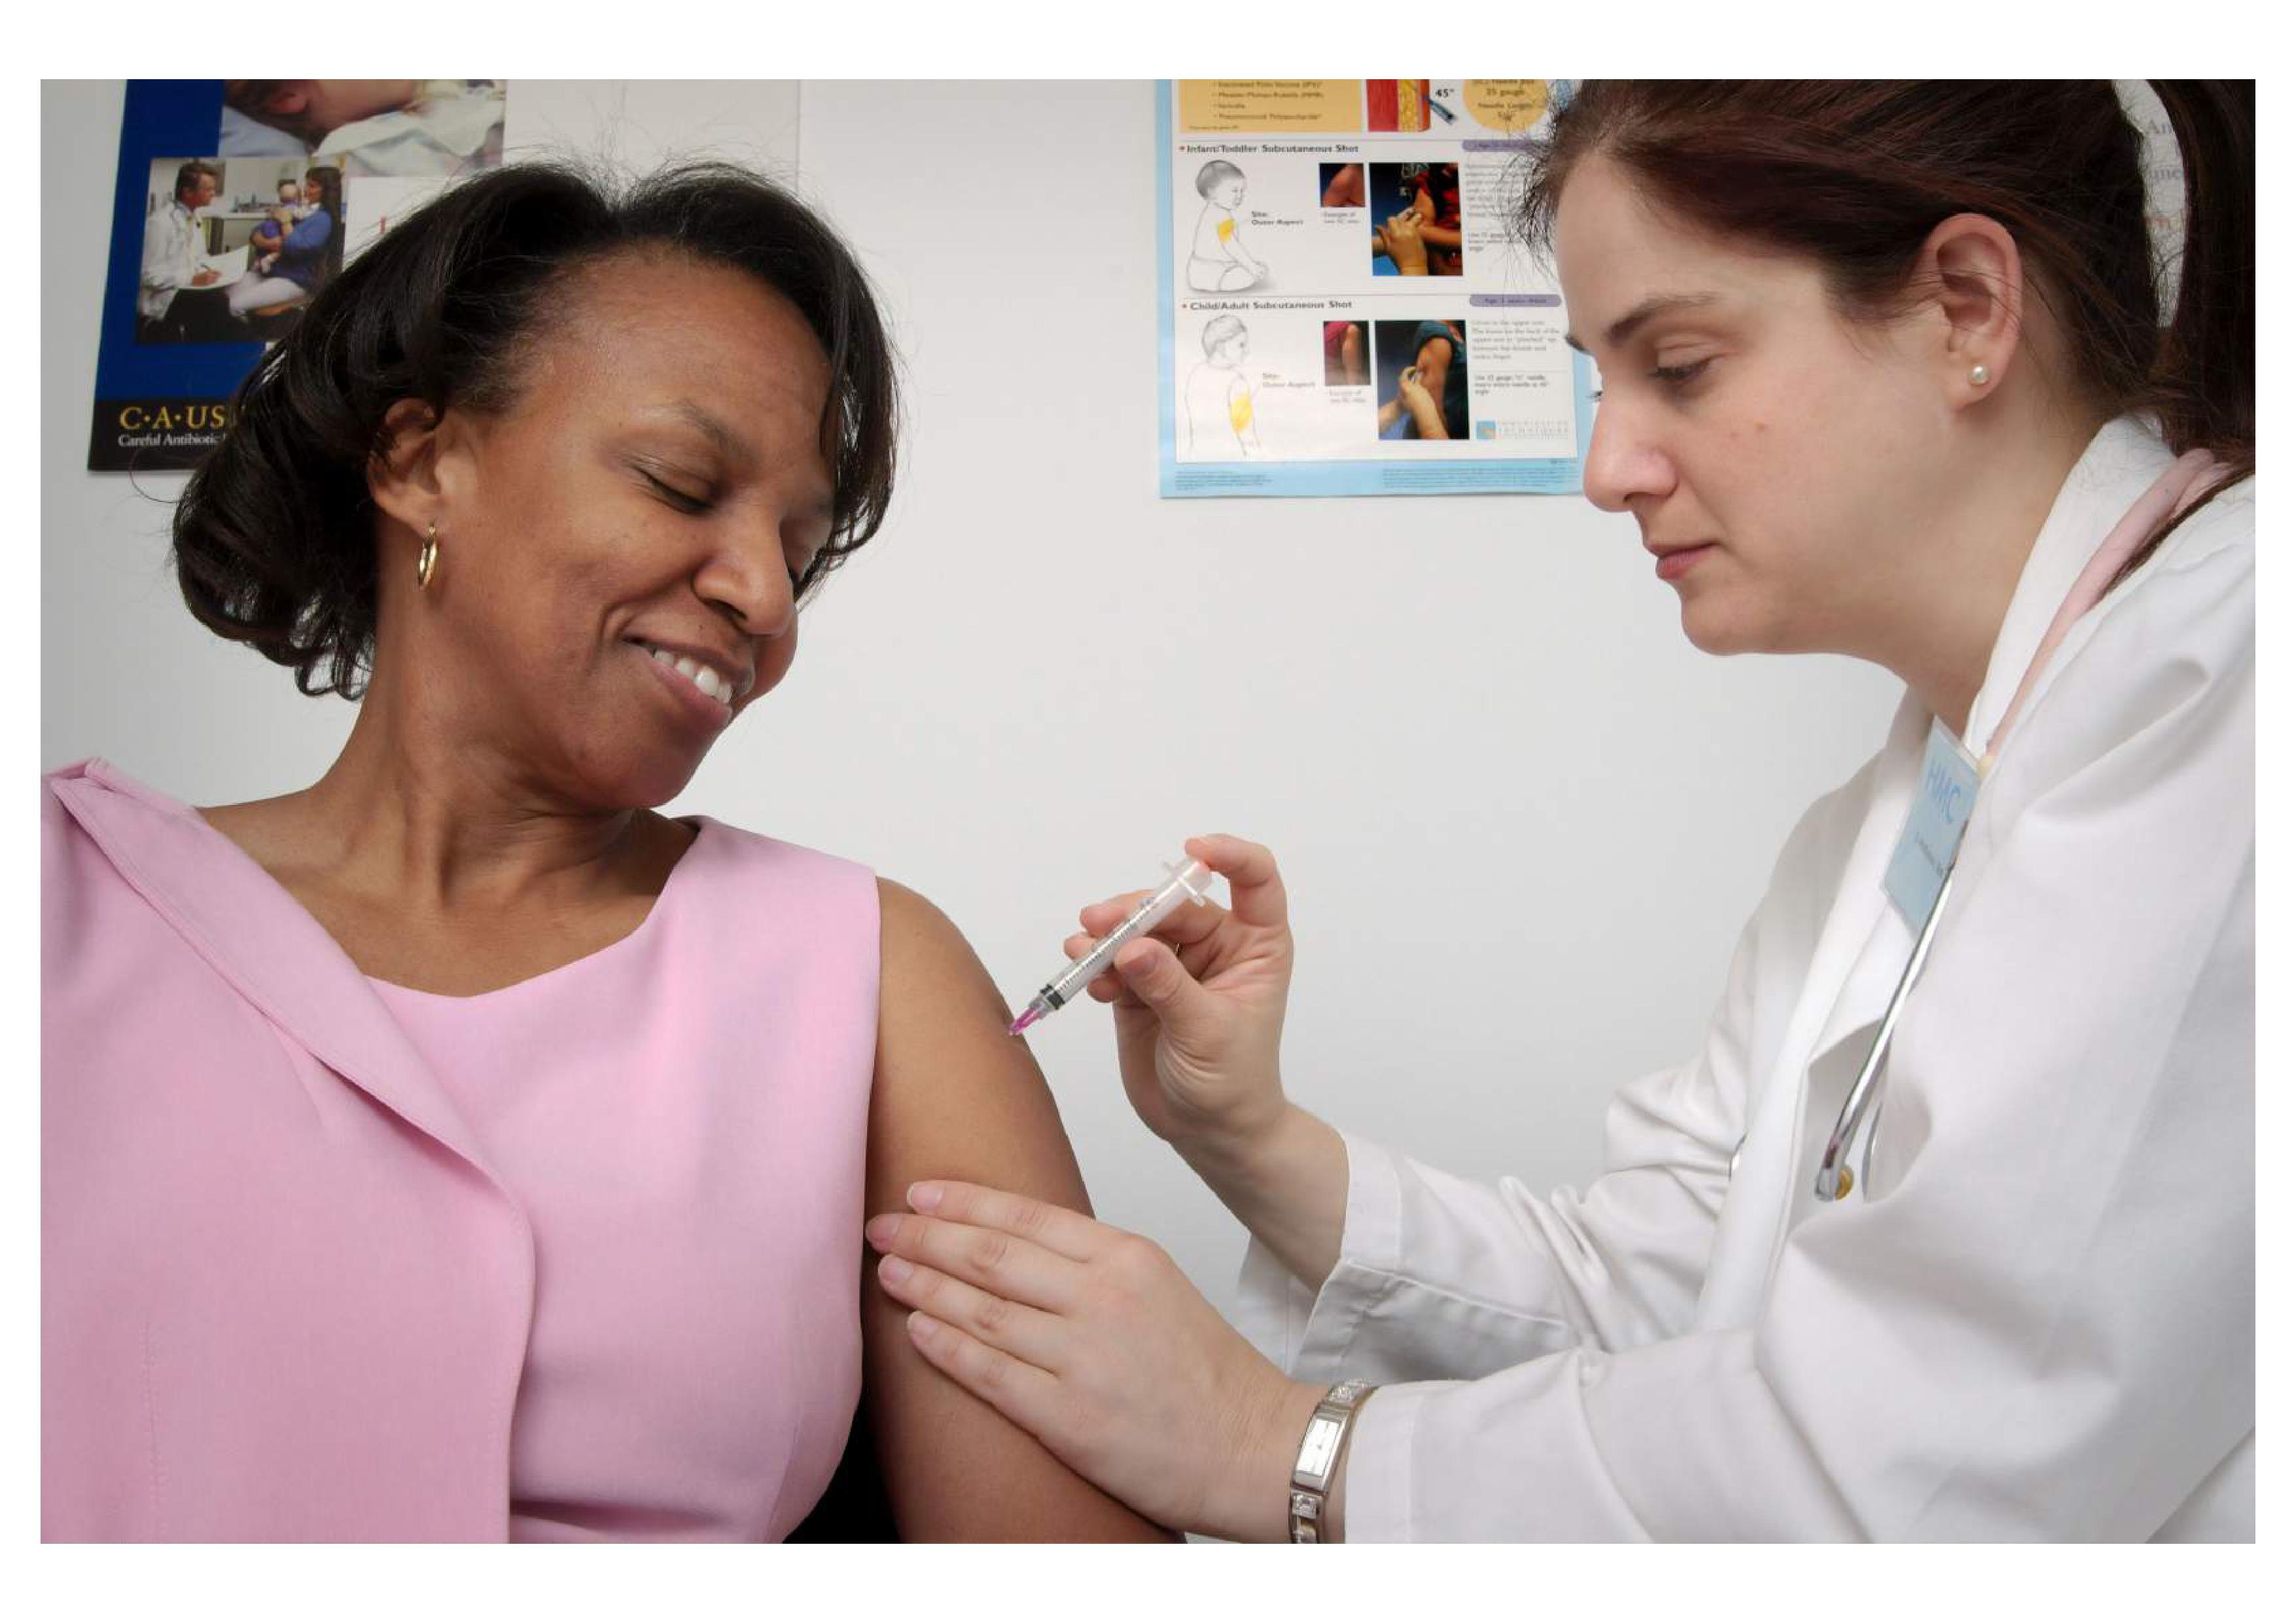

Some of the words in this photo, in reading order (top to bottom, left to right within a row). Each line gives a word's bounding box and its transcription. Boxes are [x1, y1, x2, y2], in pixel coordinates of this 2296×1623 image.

[1186, 144, 1258, 153] Infant/Toddler
[1262, 144, 1333, 153] Subcutaneous
[1335, 143, 1359, 153] Shot
[1190, 302, 1250, 311] Child/Adult
[1252, 300, 1325, 310] Subcutaneous
[1328, 300, 1352, 309] Shot
[118, 404, 237, 430] C·A·US
[117, 433, 162, 447] Careful
[163, 432, 220, 446] Antibiotic
